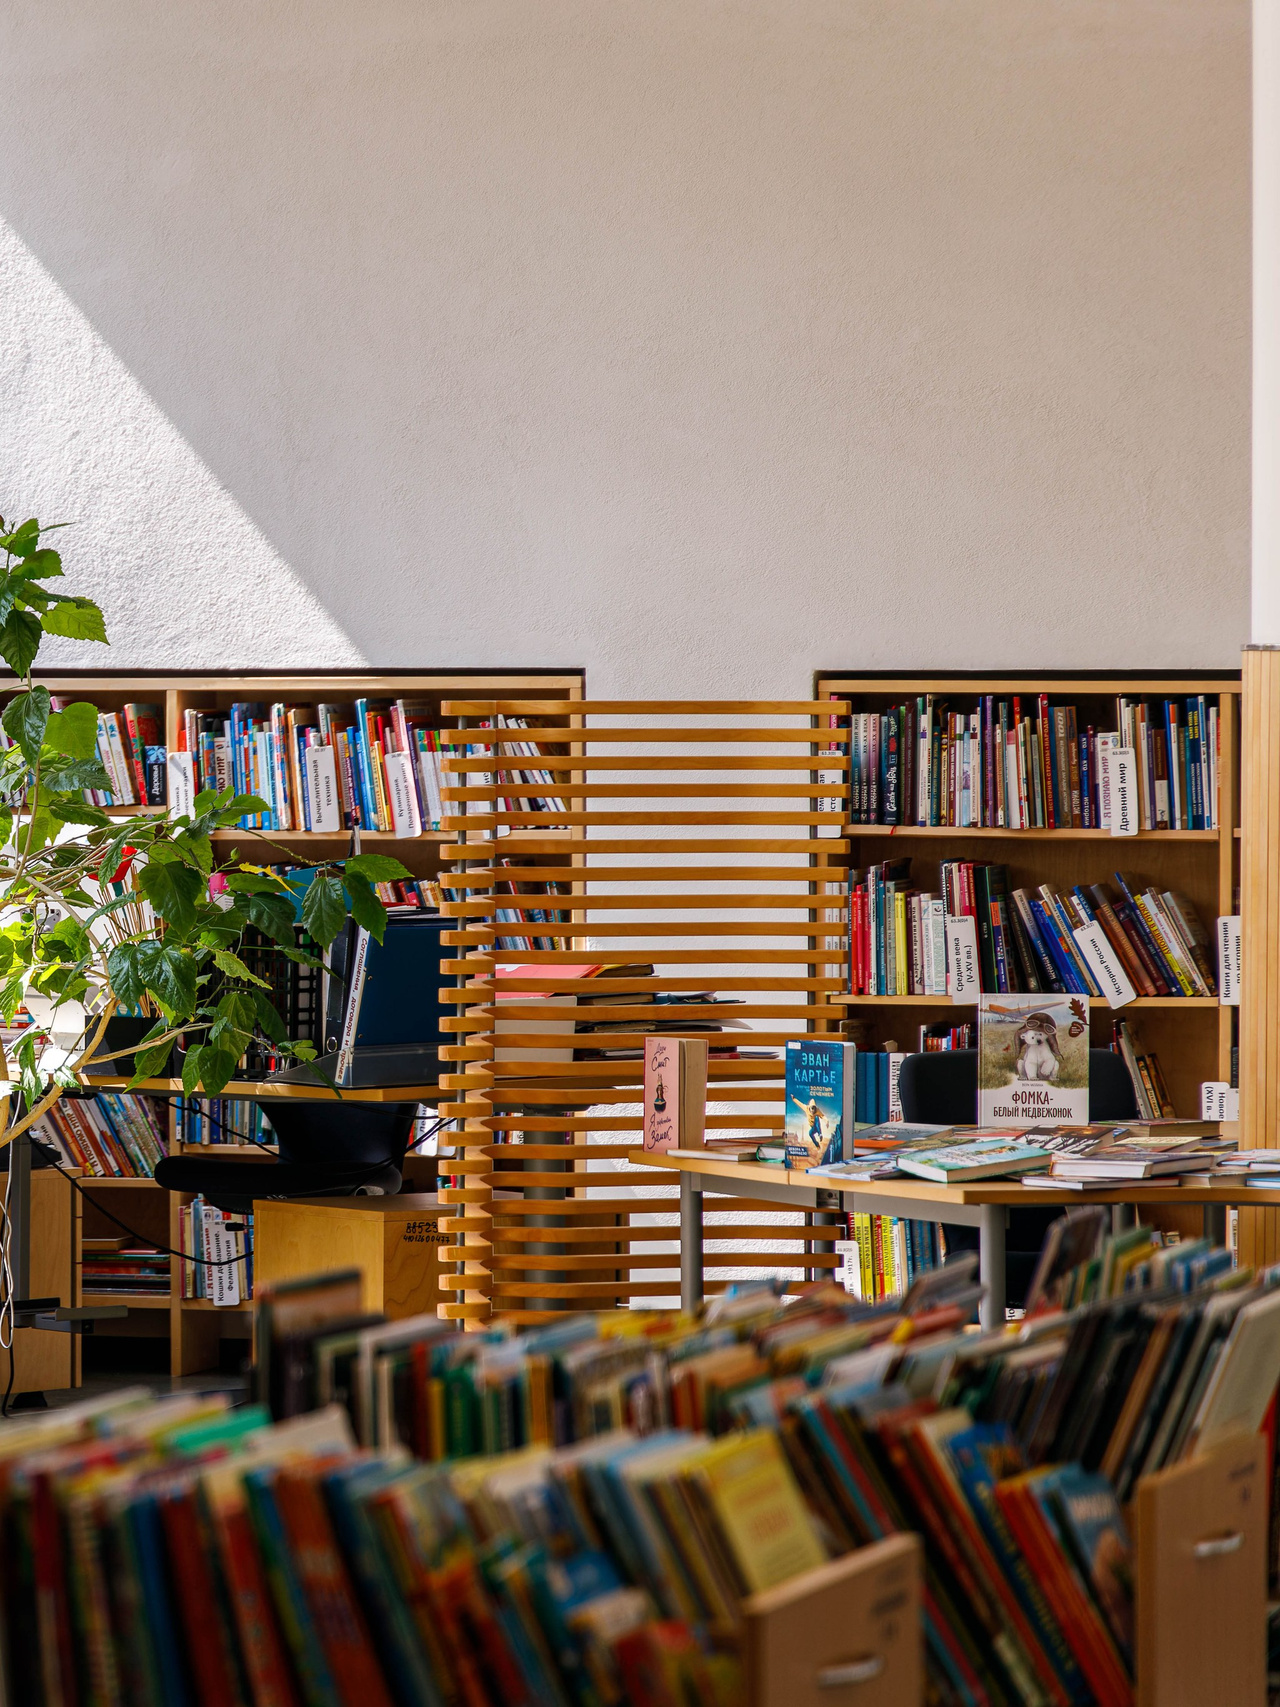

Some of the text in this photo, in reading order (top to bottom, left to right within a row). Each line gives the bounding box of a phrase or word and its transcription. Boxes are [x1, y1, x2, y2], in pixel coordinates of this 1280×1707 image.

[313, 760, 322, 824] Вычислительная
[324, 776, 332, 806] техника
[394, 776, 403, 817] Кулинария.
[400, 763, 414, 829] Поваренные книги
[1102, 776, 1111, 810] ПОЗНАЮ
[1118, 763, 1129, 831] Древний мир
[1140, 902, 1152, 923] ОКНО
[1154, 929, 1172, 954] ЕВРОПУ
[353, 937, 367, 992] Соглашения,
[954, 938, 964, 992] Средние века
[1090, 938, 1105, 965] России
[1222, 922, 1232, 998] Книги для чтения
[965, 962, 975, 983] (V-XV
[1104, 964, 1123, 996] История
[346, 997, 356, 1037] договора
[337, 1050, 347, 1080] прочее
[794, 1068, 836, 1083] КАРТЬЕ
[802, 1052, 830, 1067] ЭВАН
[1012, 1091, 1054, 1105] ФОМКА-
[1205, 1087, 1213, 1104] (XVI
[66, 1112, 78, 1130] МИР
[994, 1106, 1073, 1119] БЕЛЫЙ МЕДВЕЖОНОК
[74, 1129, 95, 1164] ПОЗНАЮ
[216, 1276, 224, 1302] Кошки
